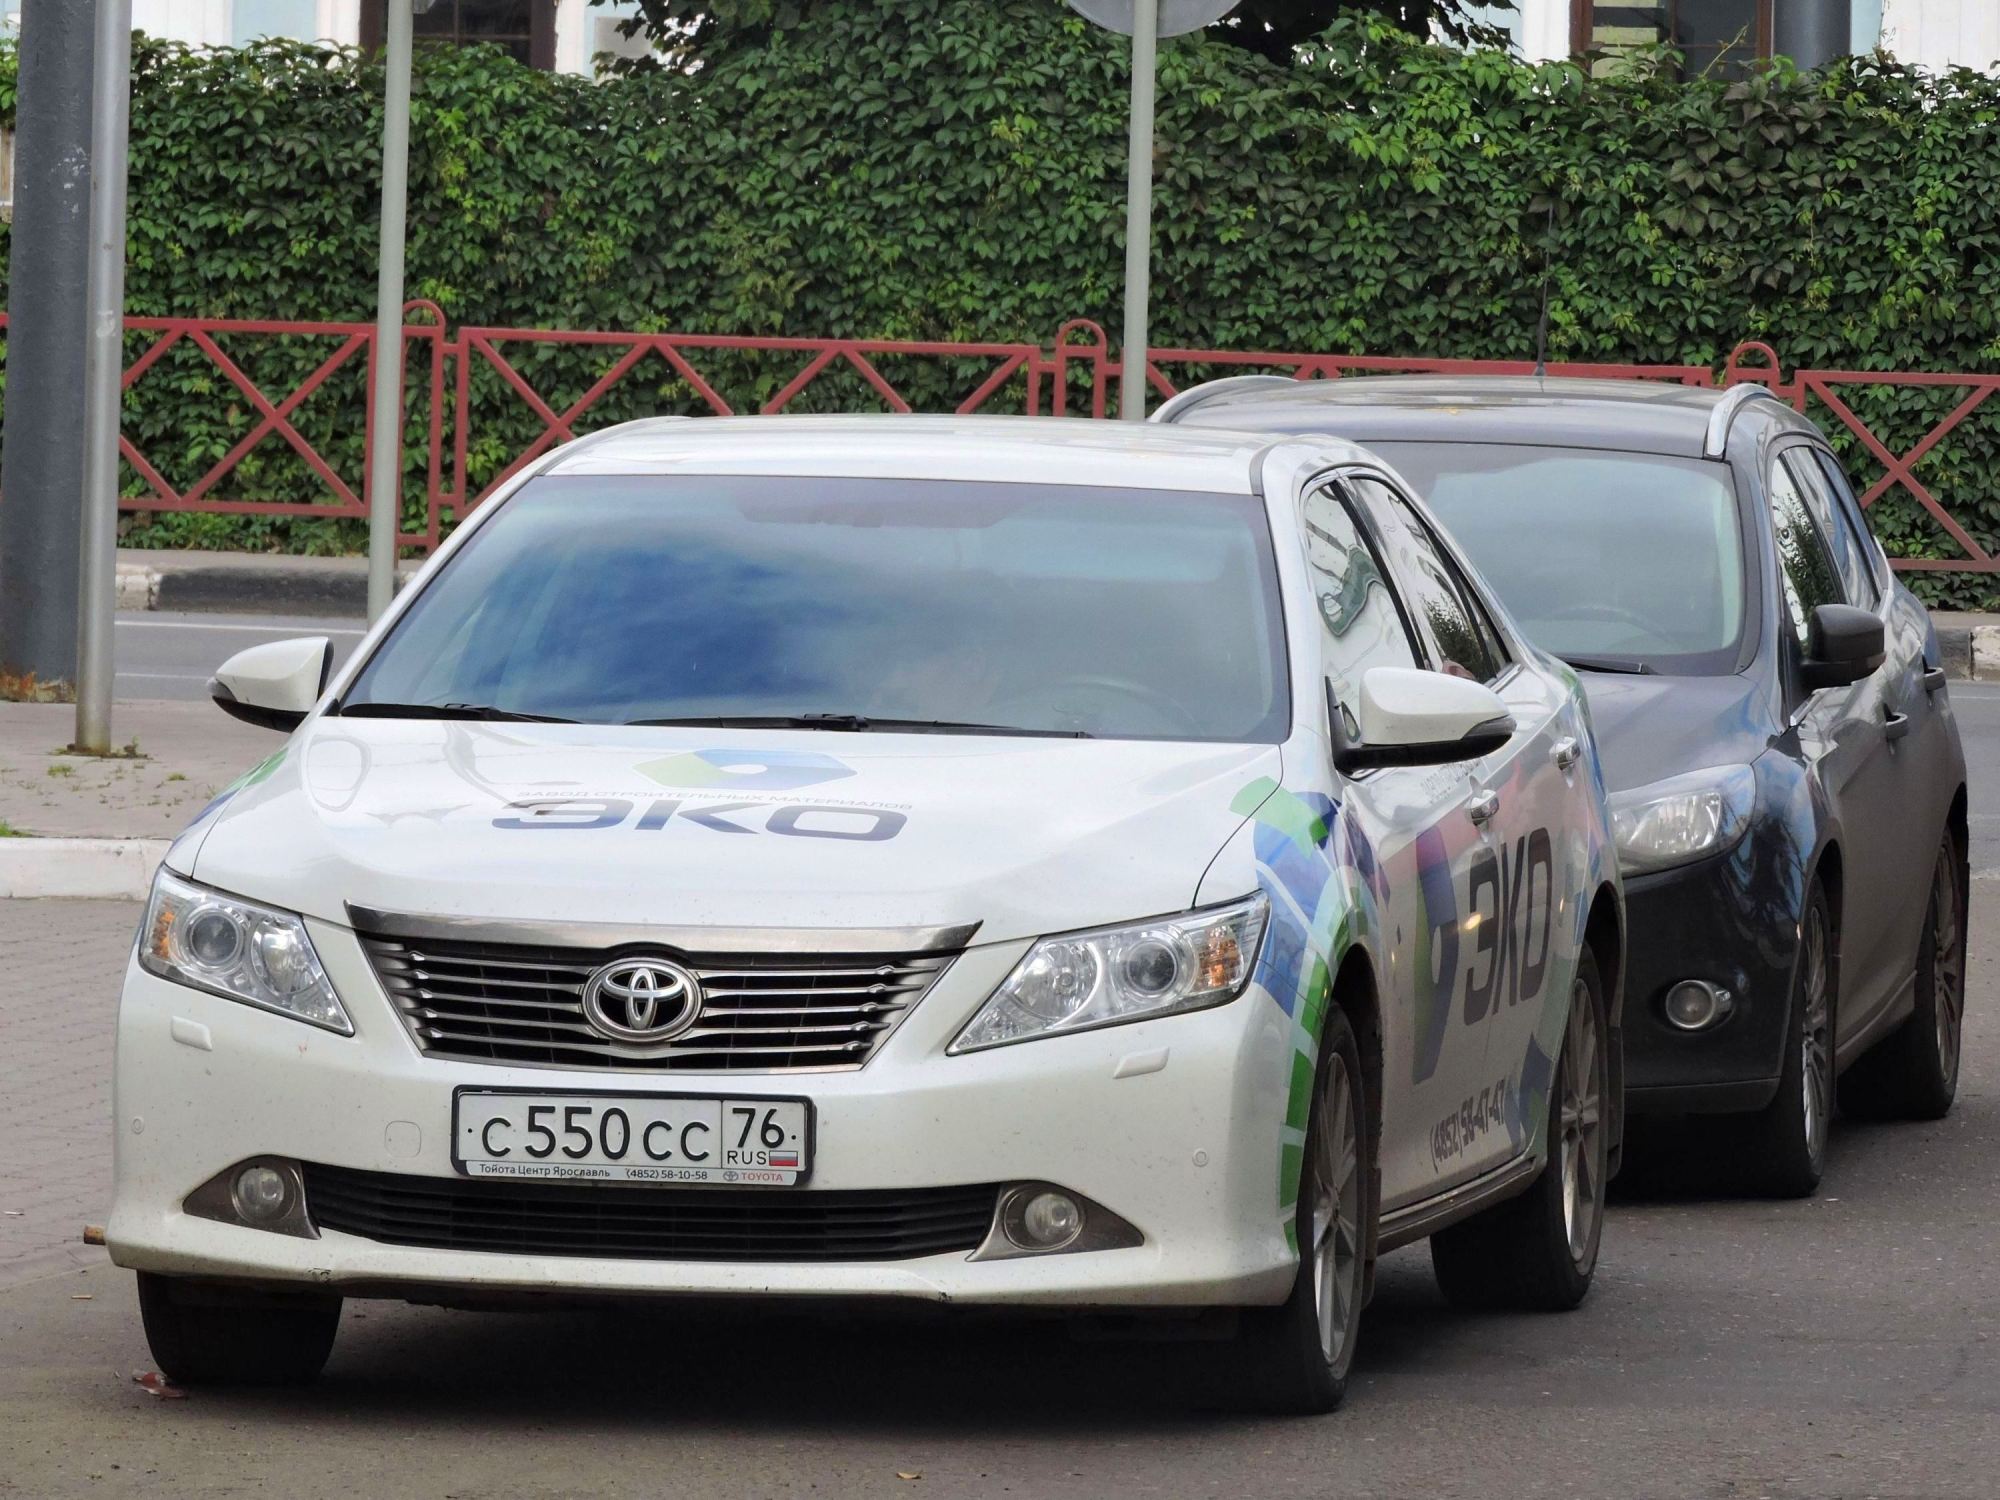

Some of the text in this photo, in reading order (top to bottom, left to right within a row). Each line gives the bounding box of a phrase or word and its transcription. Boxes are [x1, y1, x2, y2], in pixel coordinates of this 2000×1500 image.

[769, 796, 913, 809] МАТЕРИАЛОВ
[492, 799, 908, 841] ЭКО
[1463, 827, 1552, 1026] ЭКО
[732, 1107, 785, 1149] 76
[727, 1150, 767, 1165] RUS
[480, 1163, 515, 1174] Тойота
[518, 1165, 550, 1177] Центр
[553, 1166, 610, 1177] Ярославль
[741, 1172, 783, 1182] TOYOTA
